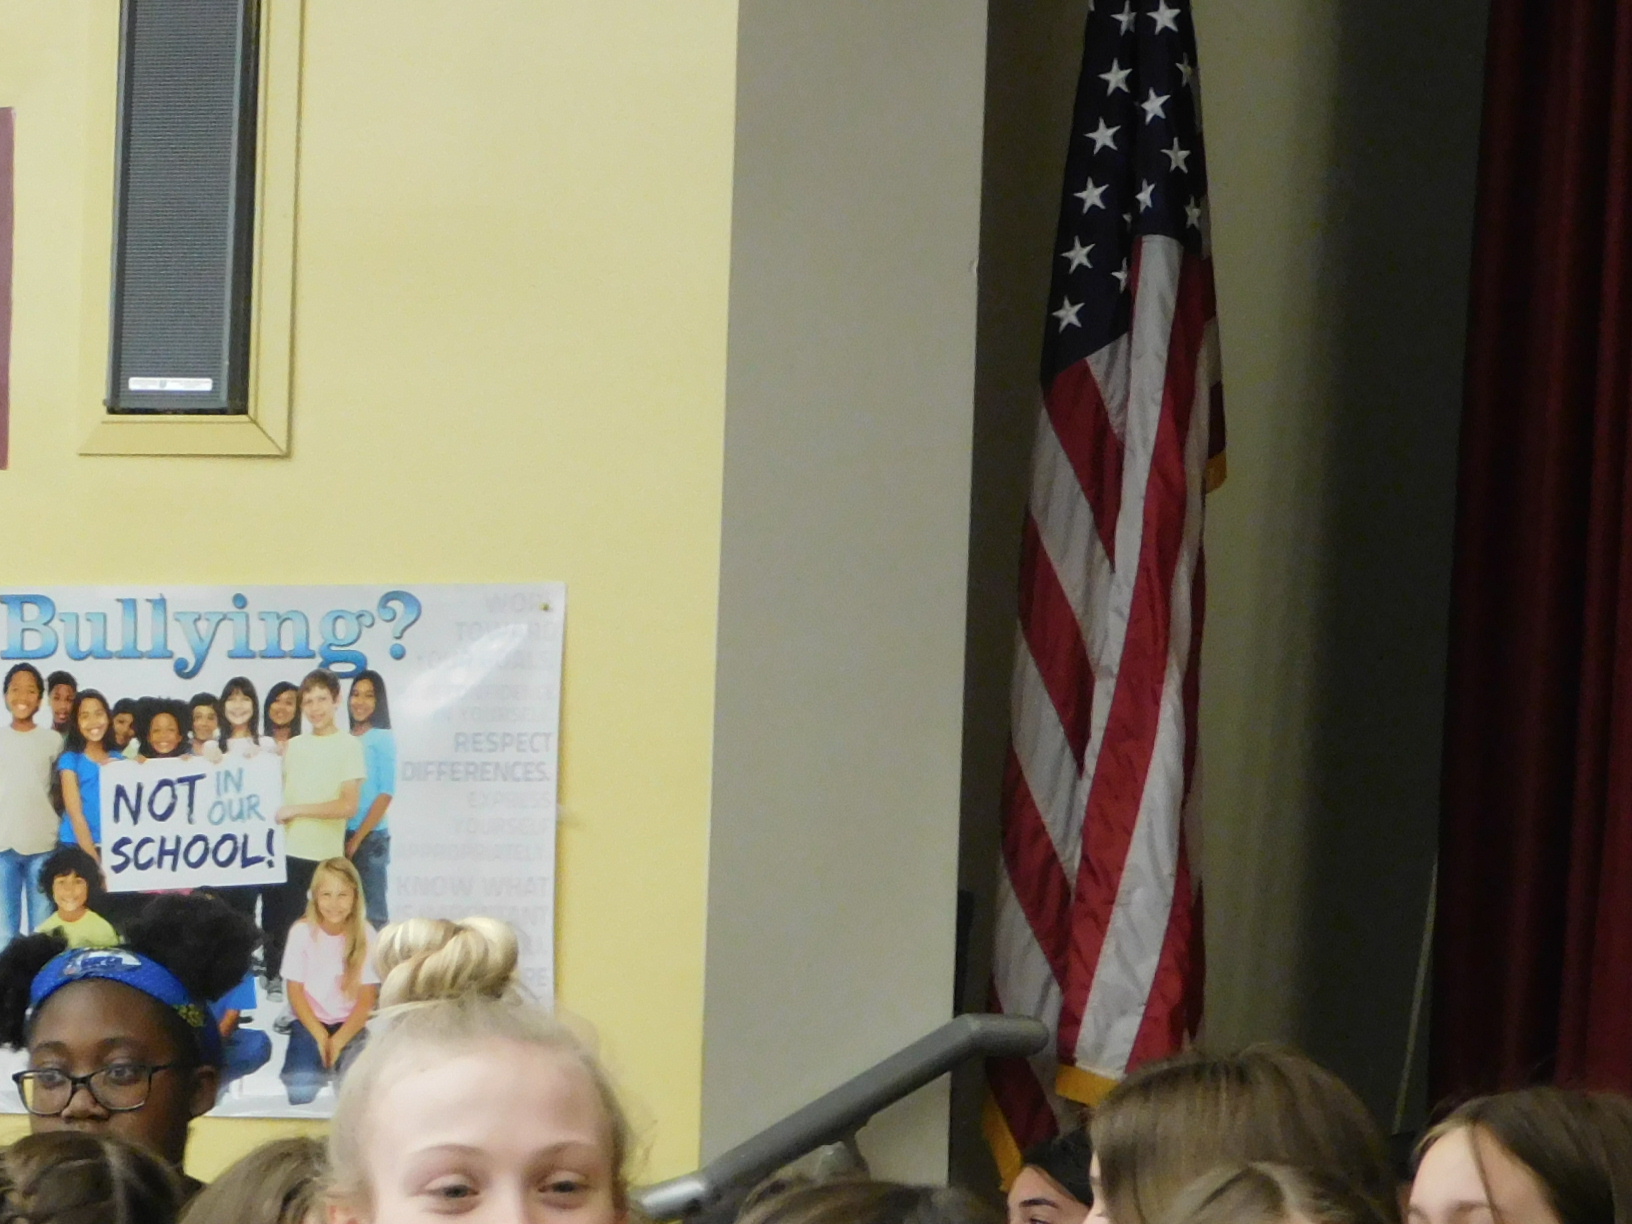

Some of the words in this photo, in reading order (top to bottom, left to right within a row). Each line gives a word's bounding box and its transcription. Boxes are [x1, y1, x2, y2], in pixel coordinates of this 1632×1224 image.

[453, 731, 554, 753] RESPECT
[215, 767, 244, 797] IN
[400, 760, 550, 782] DIFFERENCES.
[112, 773, 207, 826] NOT
[207, 794, 264, 827] OUR
[110, 827, 276, 875] SCHOOL!
